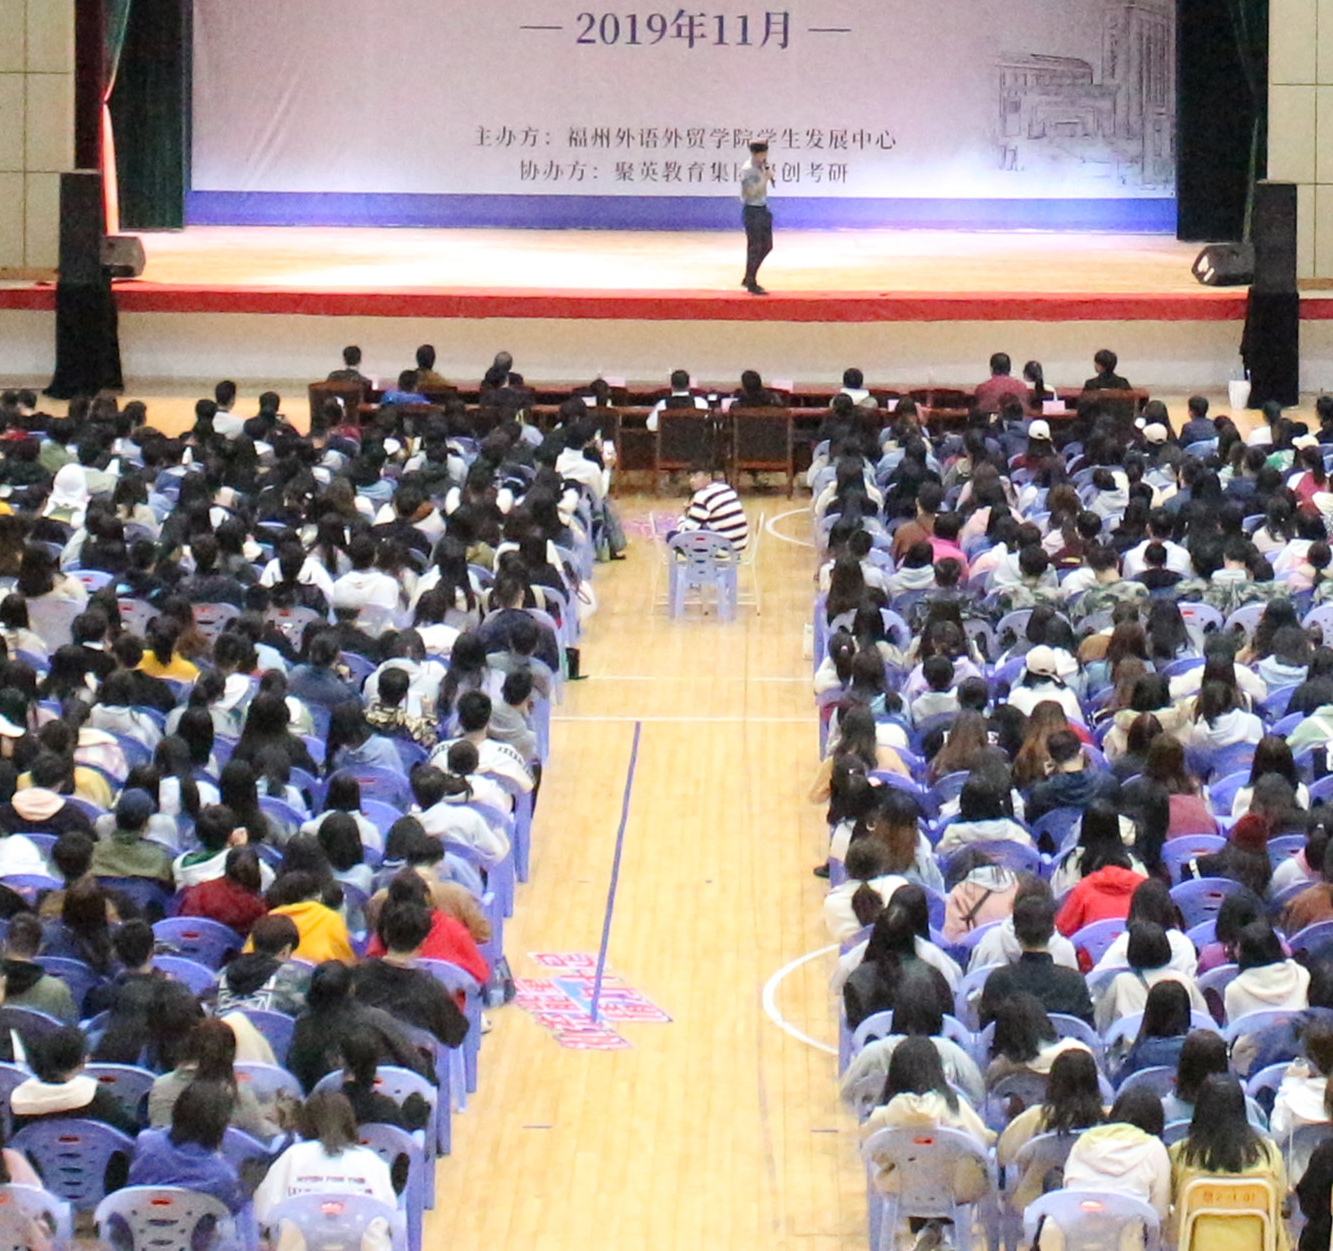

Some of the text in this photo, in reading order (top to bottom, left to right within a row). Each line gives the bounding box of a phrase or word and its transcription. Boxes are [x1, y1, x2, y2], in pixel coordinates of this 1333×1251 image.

[519, 158, 849, 184] 协办方：聚英教育集创考研
